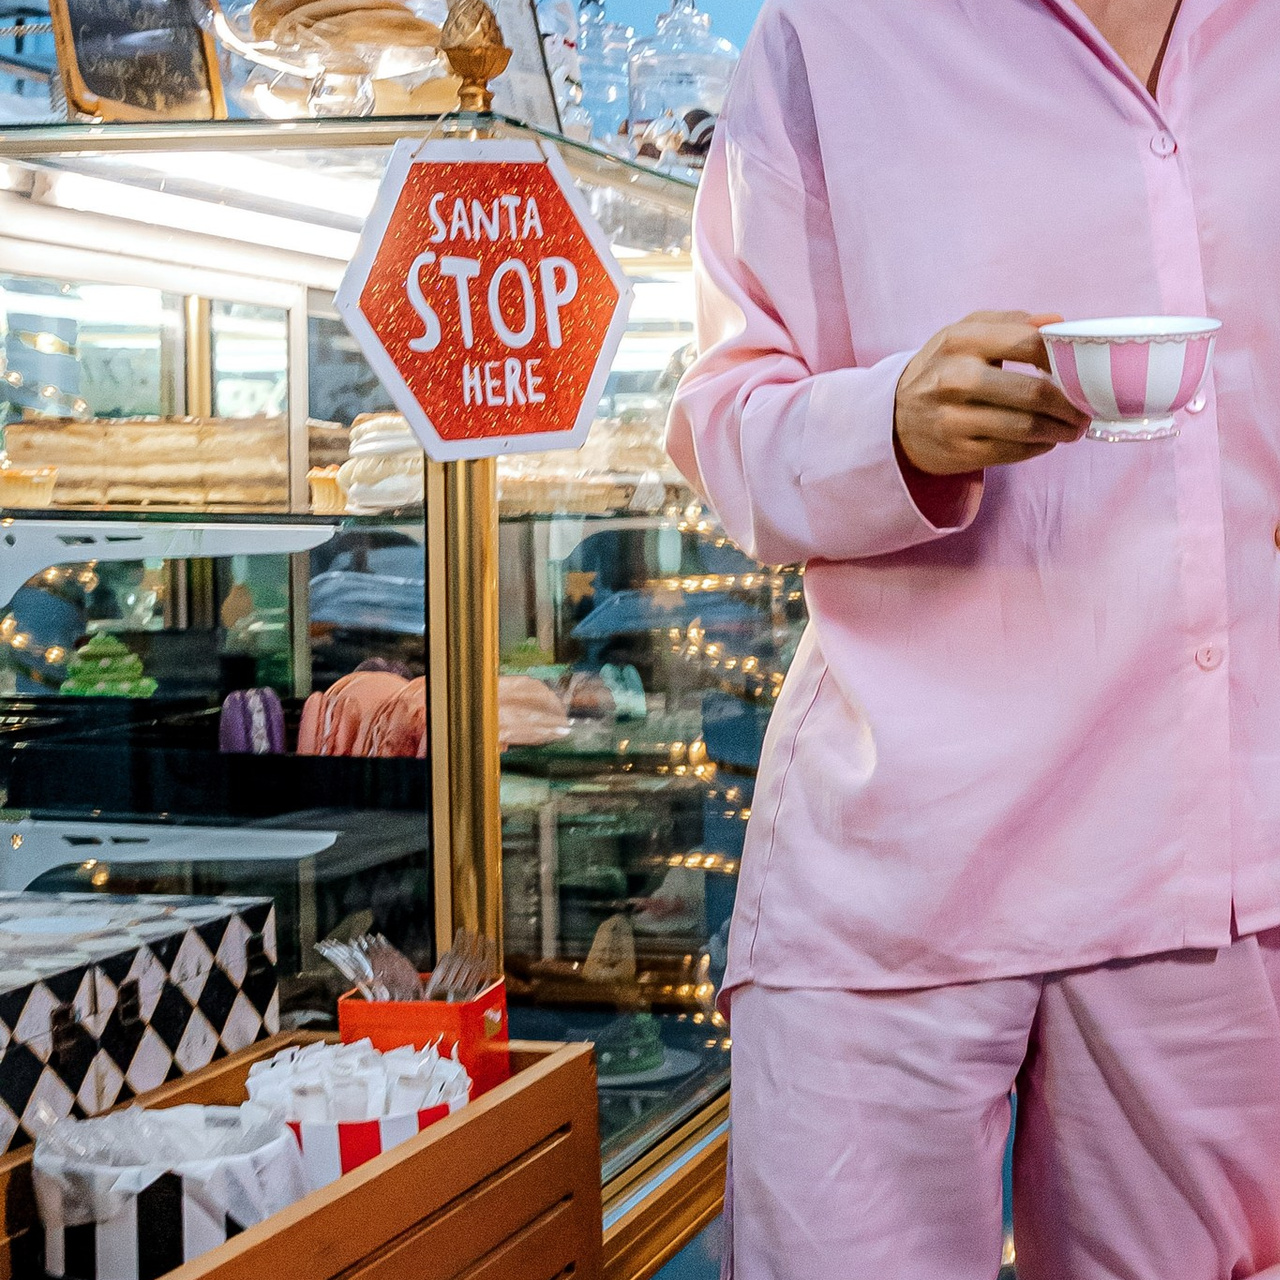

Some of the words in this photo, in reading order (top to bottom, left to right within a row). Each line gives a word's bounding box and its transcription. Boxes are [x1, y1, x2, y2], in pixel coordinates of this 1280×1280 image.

[428, 192, 544, 244] SANTA
[406, 250, 579, 353] STOP
[462, 356, 547, 407] HERE
